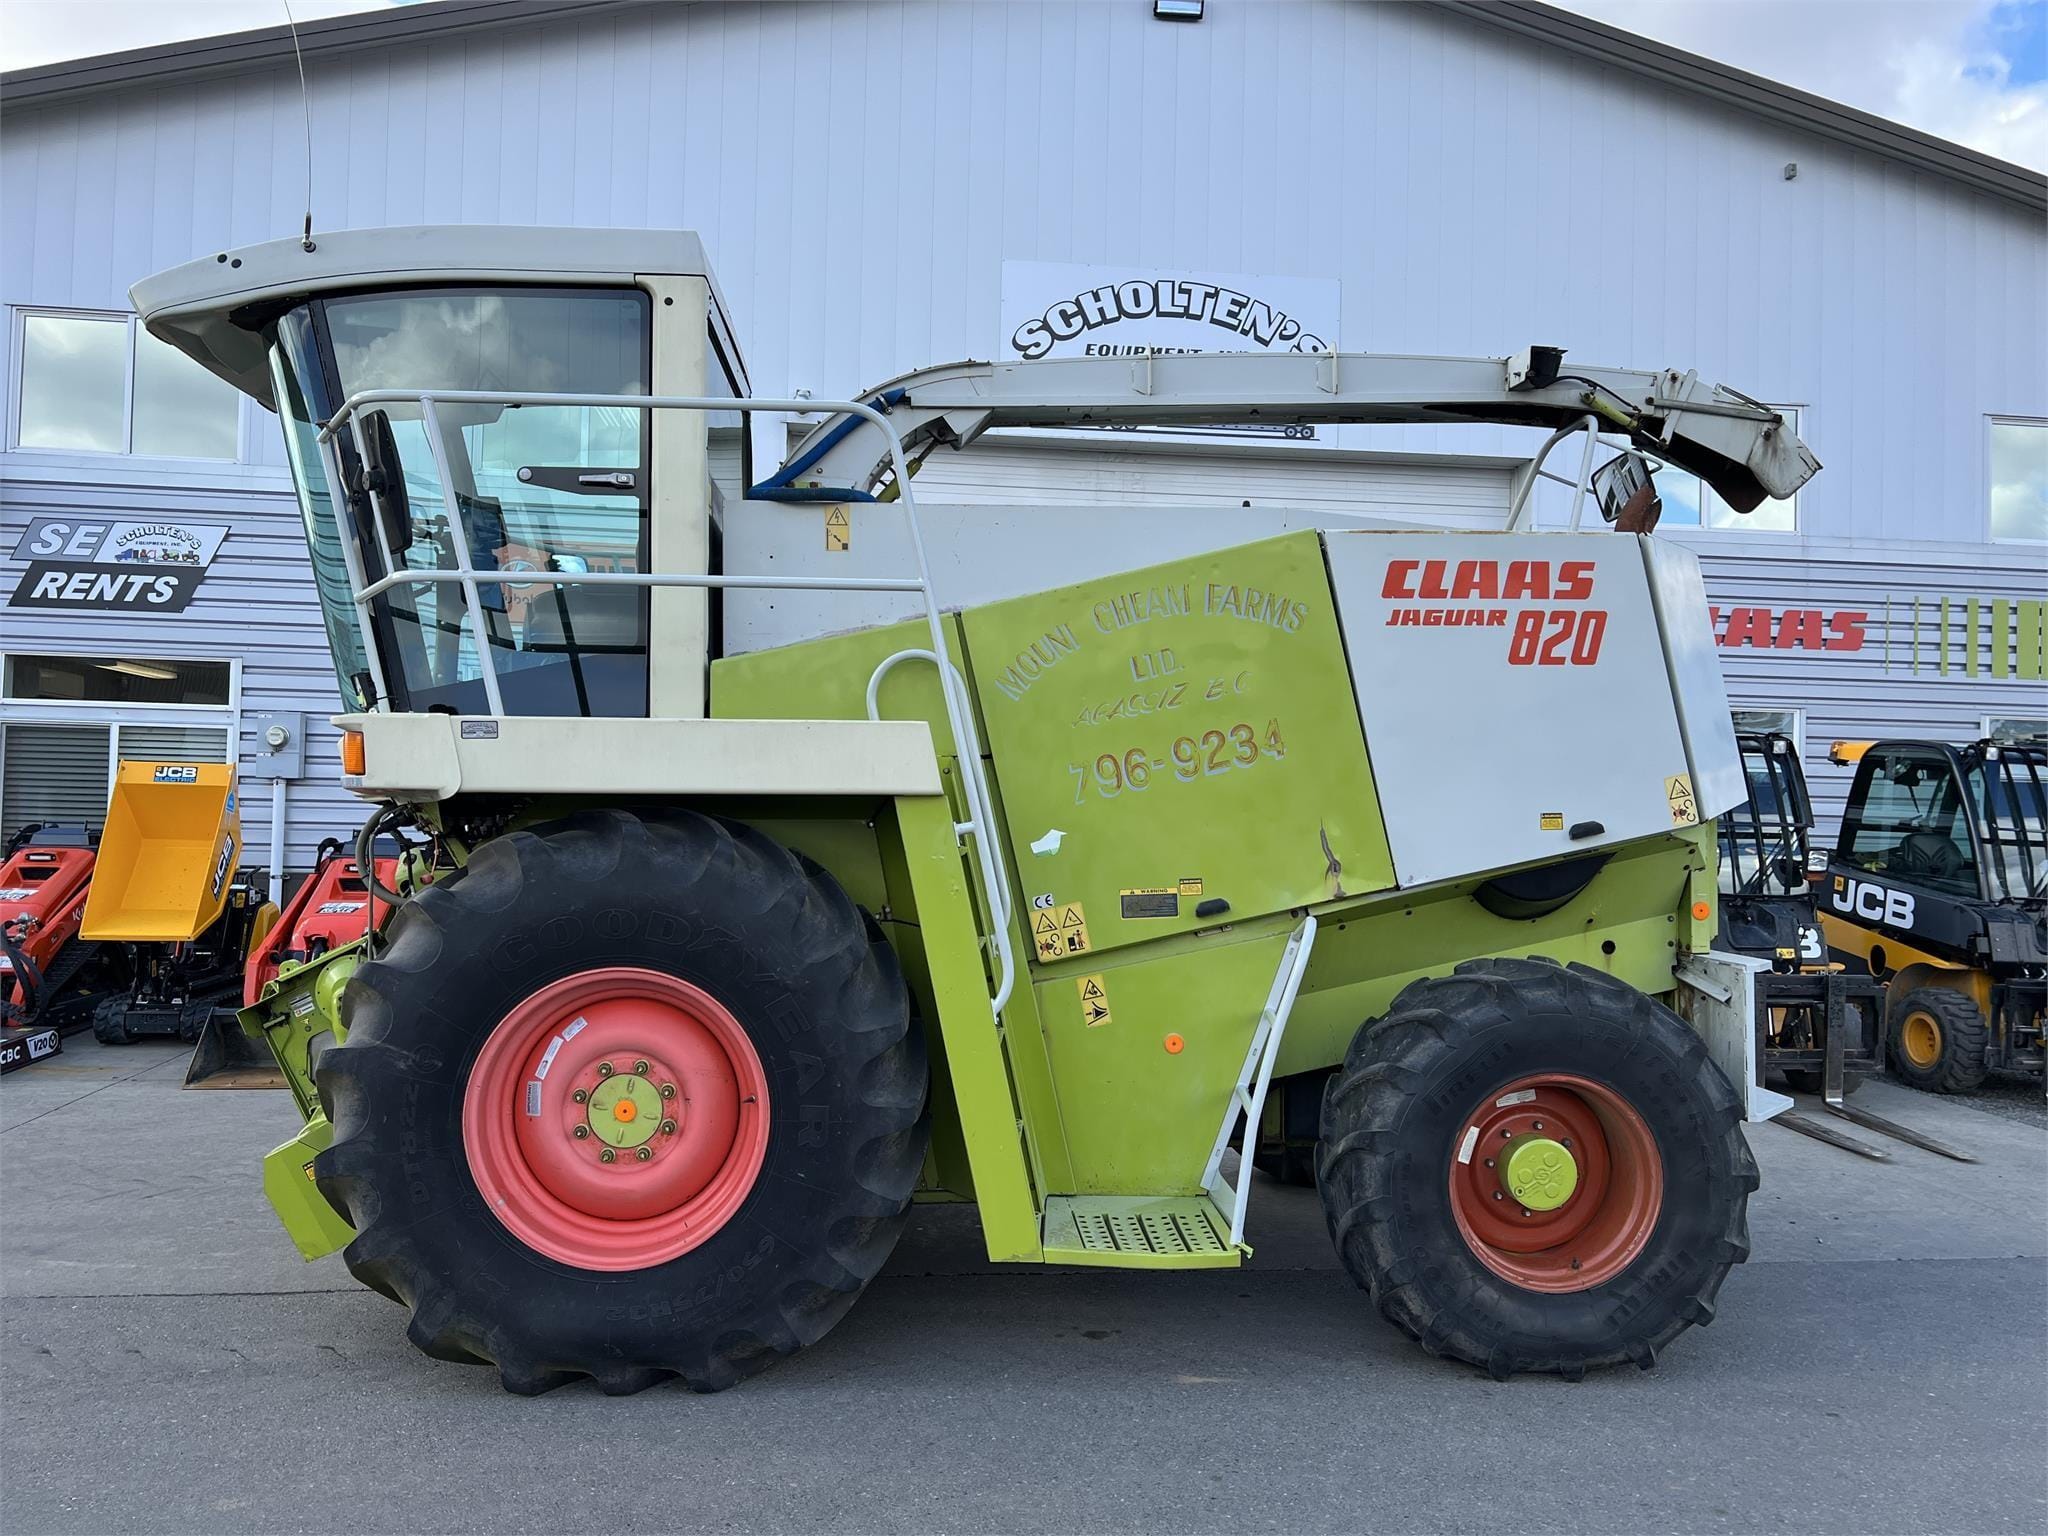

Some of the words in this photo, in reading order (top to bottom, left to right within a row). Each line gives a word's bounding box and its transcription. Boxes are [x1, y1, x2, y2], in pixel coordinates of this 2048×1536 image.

[30, 523, 106, 556] SE
[116, 525, 202, 550] SCHOLTEN'S
[30, 571, 179, 604] RENTS
[1381, 560, 1596, 600] CLAAS
[1203, 583, 1308, 634] FARMS
[1709, 606, 1868, 651] AAS
[1385, 609, 1508, 627] JAGUAR
[1508, 610, 1608, 666] 820
[155, 767, 197, 777] JCB
[1068, 718, 1287, 805] 796-9234
[1833, 879, 1915, 929] JCB
